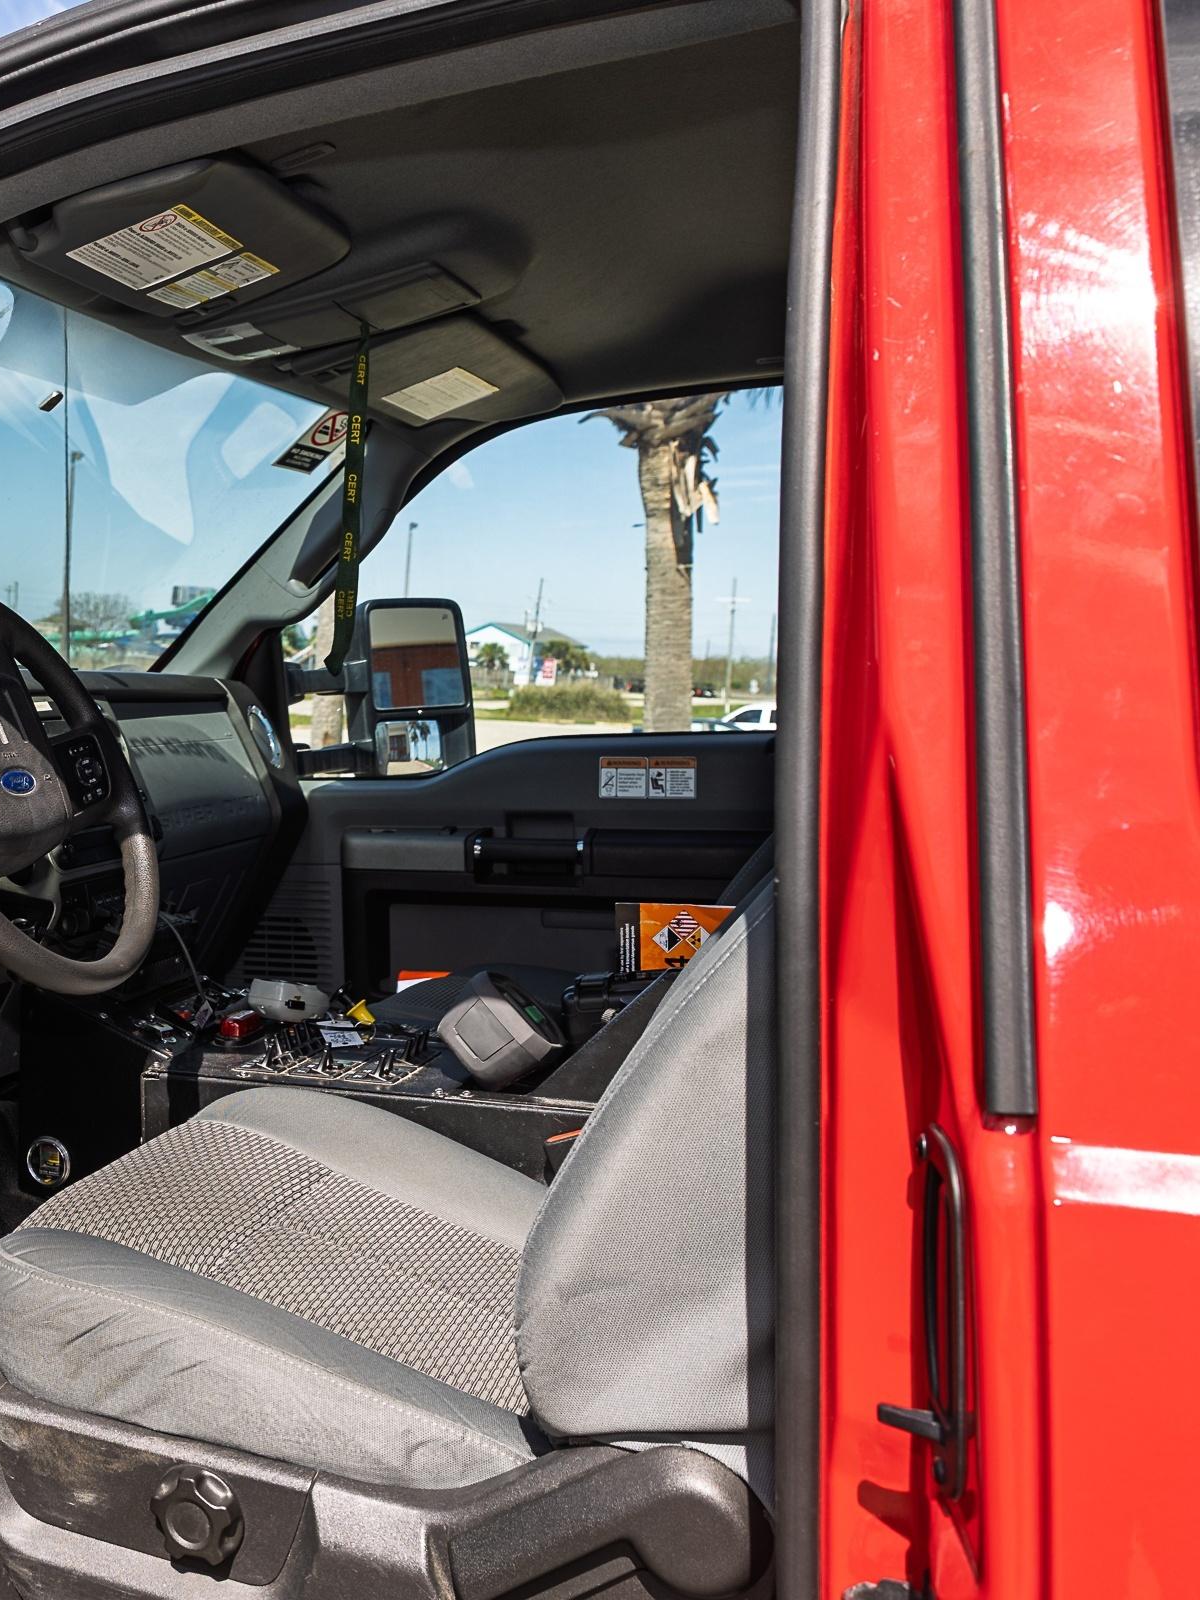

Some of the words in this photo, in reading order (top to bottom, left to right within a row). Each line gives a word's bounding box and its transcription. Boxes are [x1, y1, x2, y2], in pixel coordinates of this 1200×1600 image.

[356, 355, 366, 385] CERT
[350, 415, 361, 445] CERT
[348, 474, 357, 503] CERT
[343, 532, 353, 561] CERT
[337, 591, 345, 620] CERT
